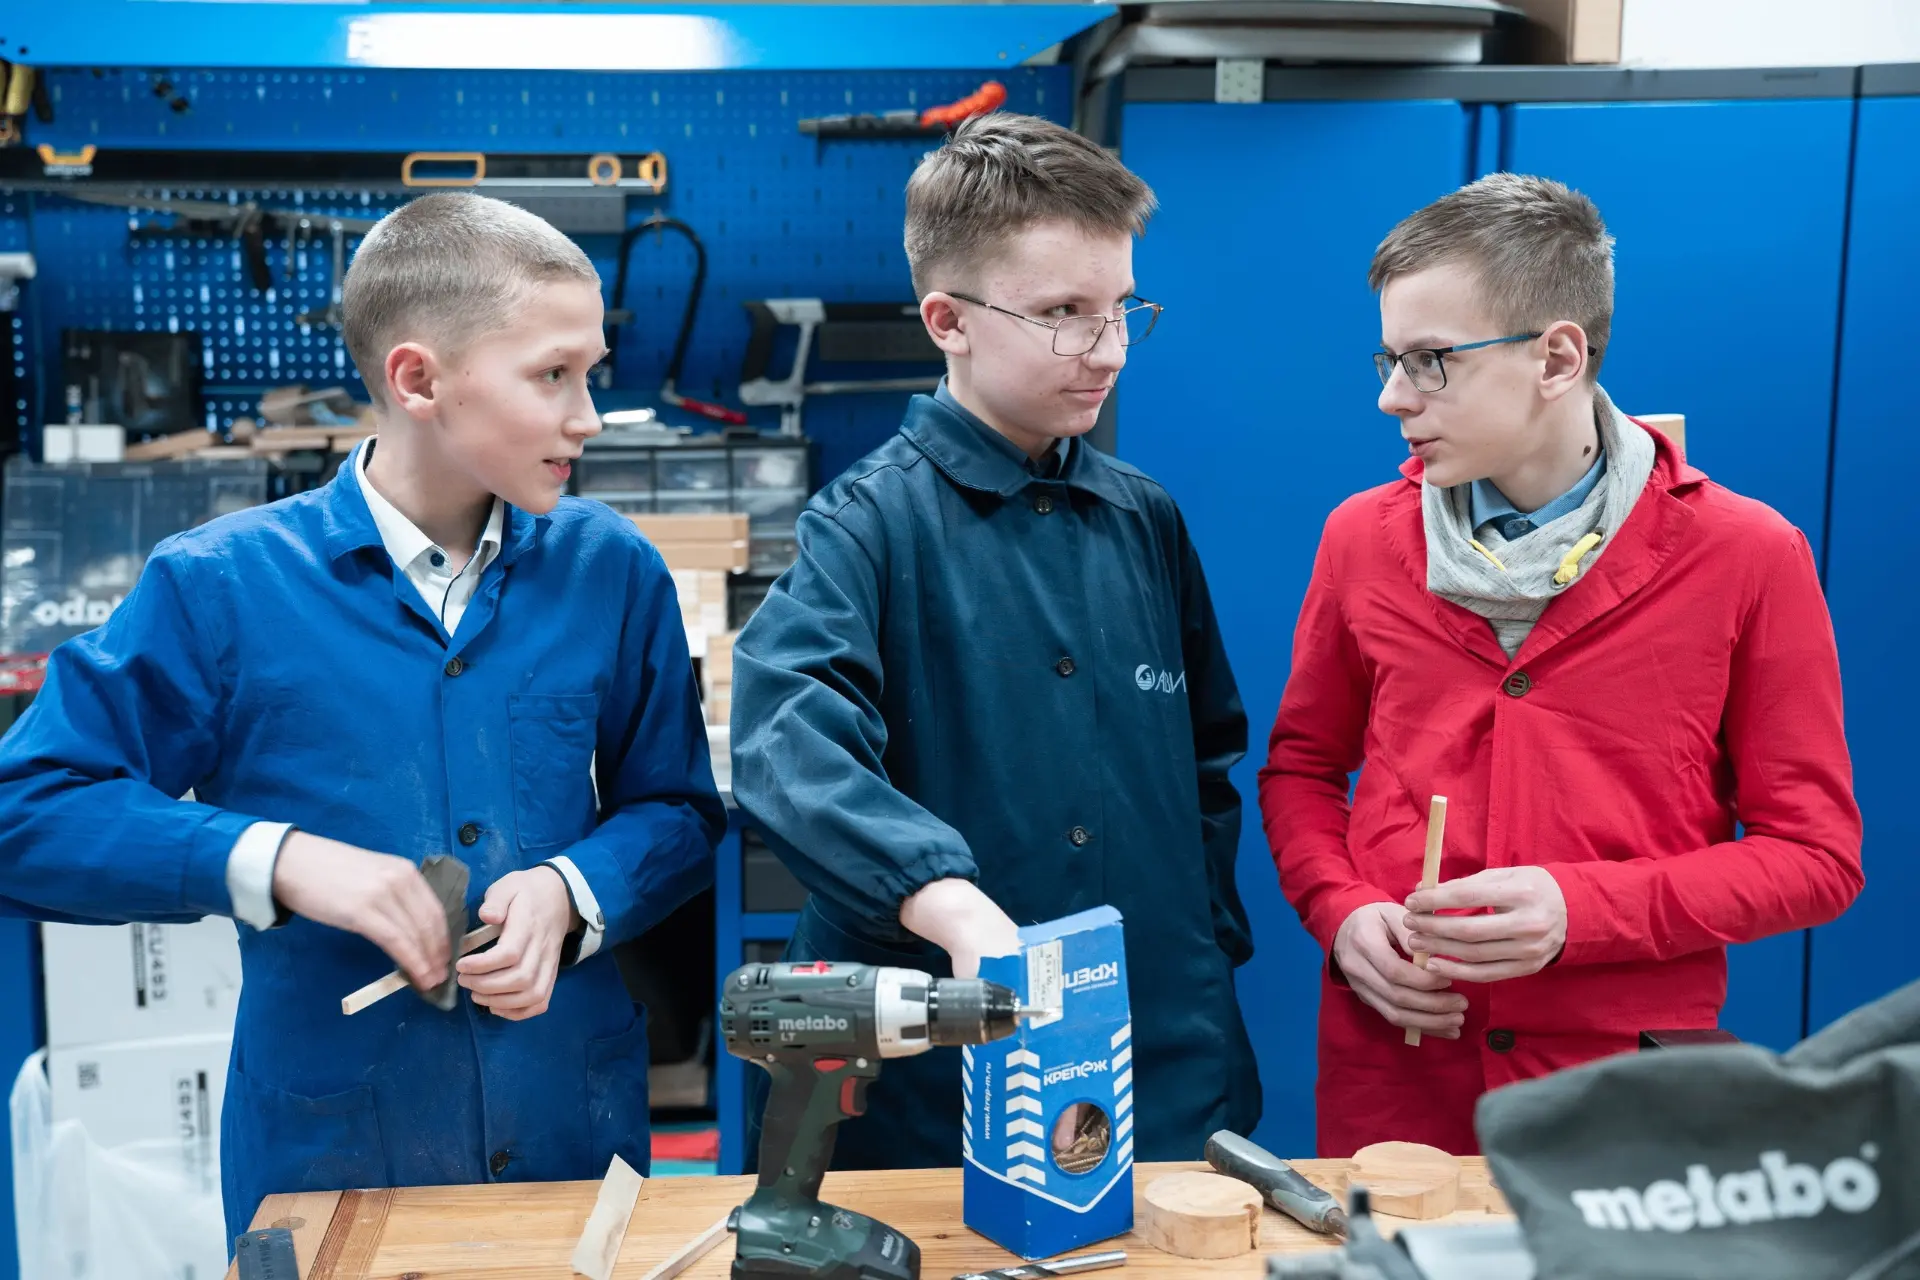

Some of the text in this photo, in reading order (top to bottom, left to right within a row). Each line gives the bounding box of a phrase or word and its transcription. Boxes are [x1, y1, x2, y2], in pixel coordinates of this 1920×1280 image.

[1060, 961, 1118, 990] КРЕП
[778, 1014, 848, 1031] metabo
[983, 1061, 992, 1140] www.krep-m.ru
[1571, 1150, 1880, 1232] metabo
